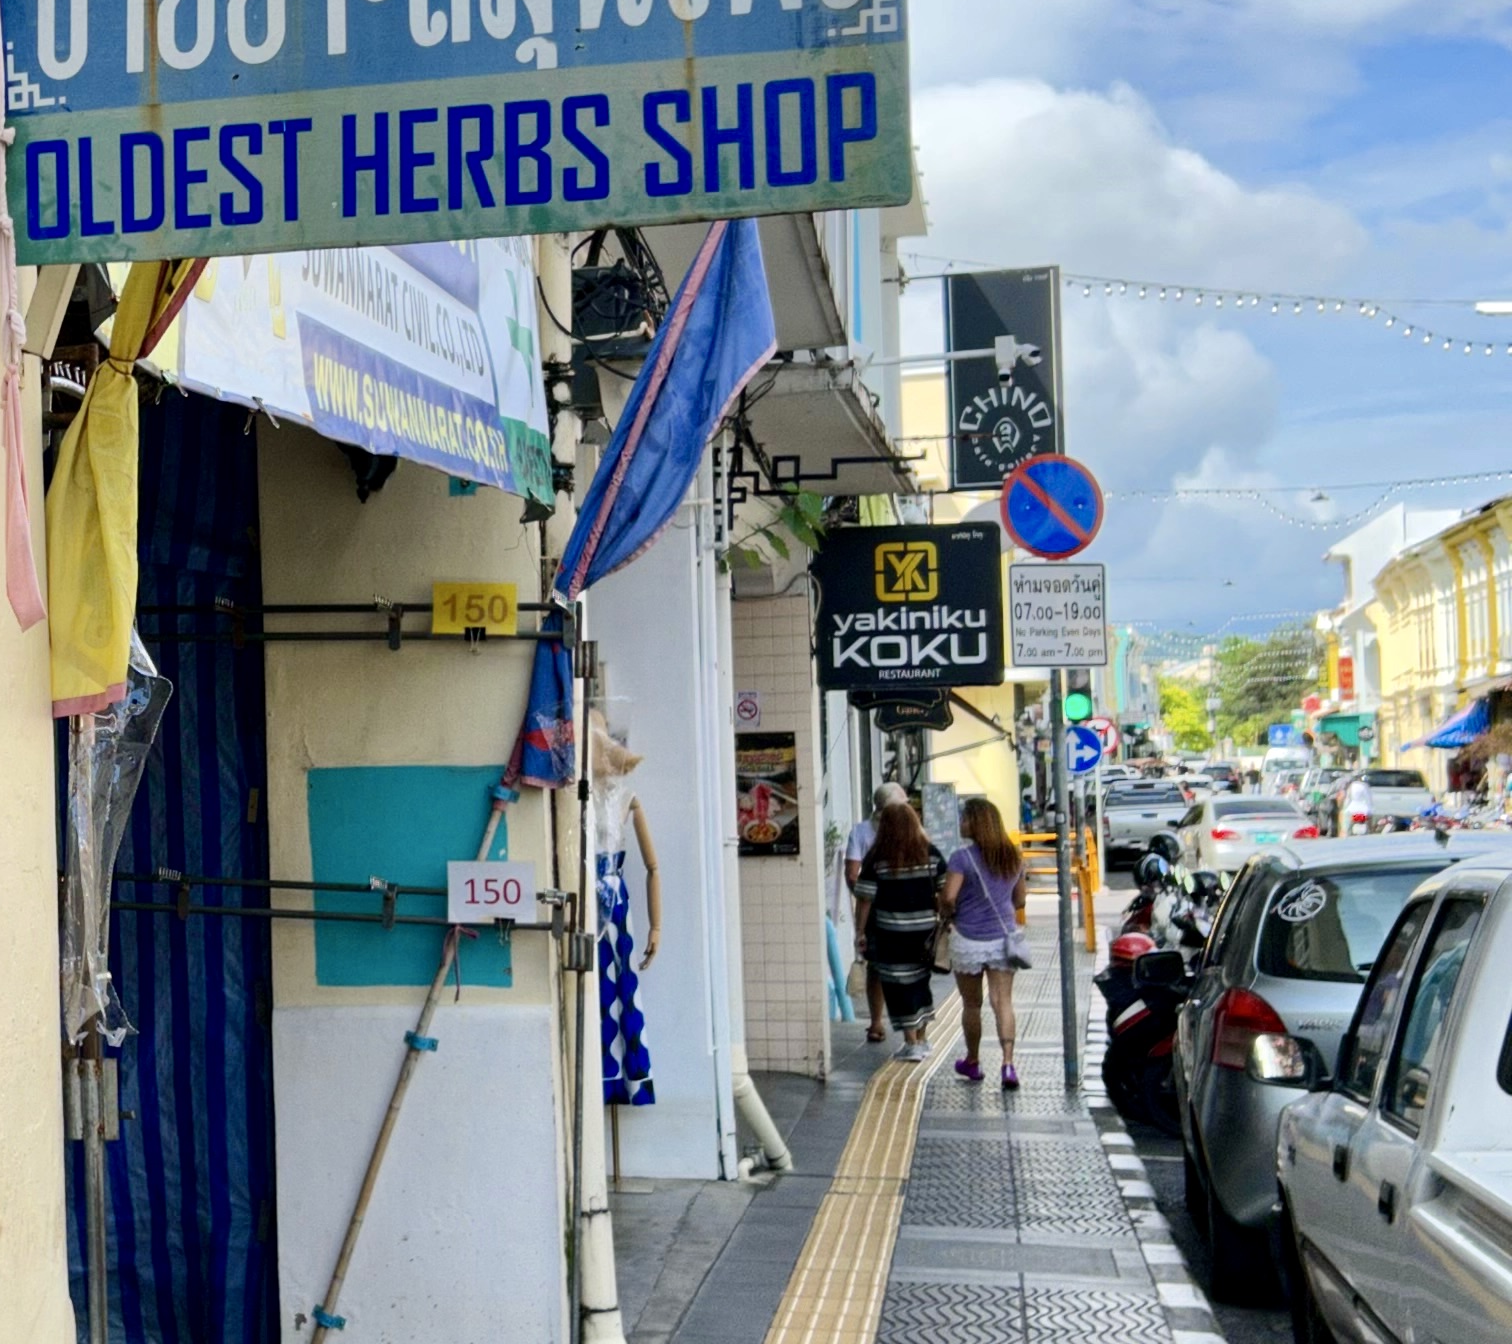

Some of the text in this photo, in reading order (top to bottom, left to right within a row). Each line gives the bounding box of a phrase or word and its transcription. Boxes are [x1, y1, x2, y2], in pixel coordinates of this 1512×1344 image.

[24, 71, 879, 243] OLDEST HERBS SHOP
[959, 385, 1052, 431] CHINO
[1013, 573, 1101, 601] ห้ามจอดวันคู่
[443, 593, 509, 625] 150
[832, 605, 987, 636] yakiniku
[1015, 626, 1101, 640] No Parking Even Days
[832, 632, 987, 668] KOKU
[1087, 648, 1103, 659] pm
[878, 668, 941, 680] RESTAURANT
[464, 878, 523, 905] 150
